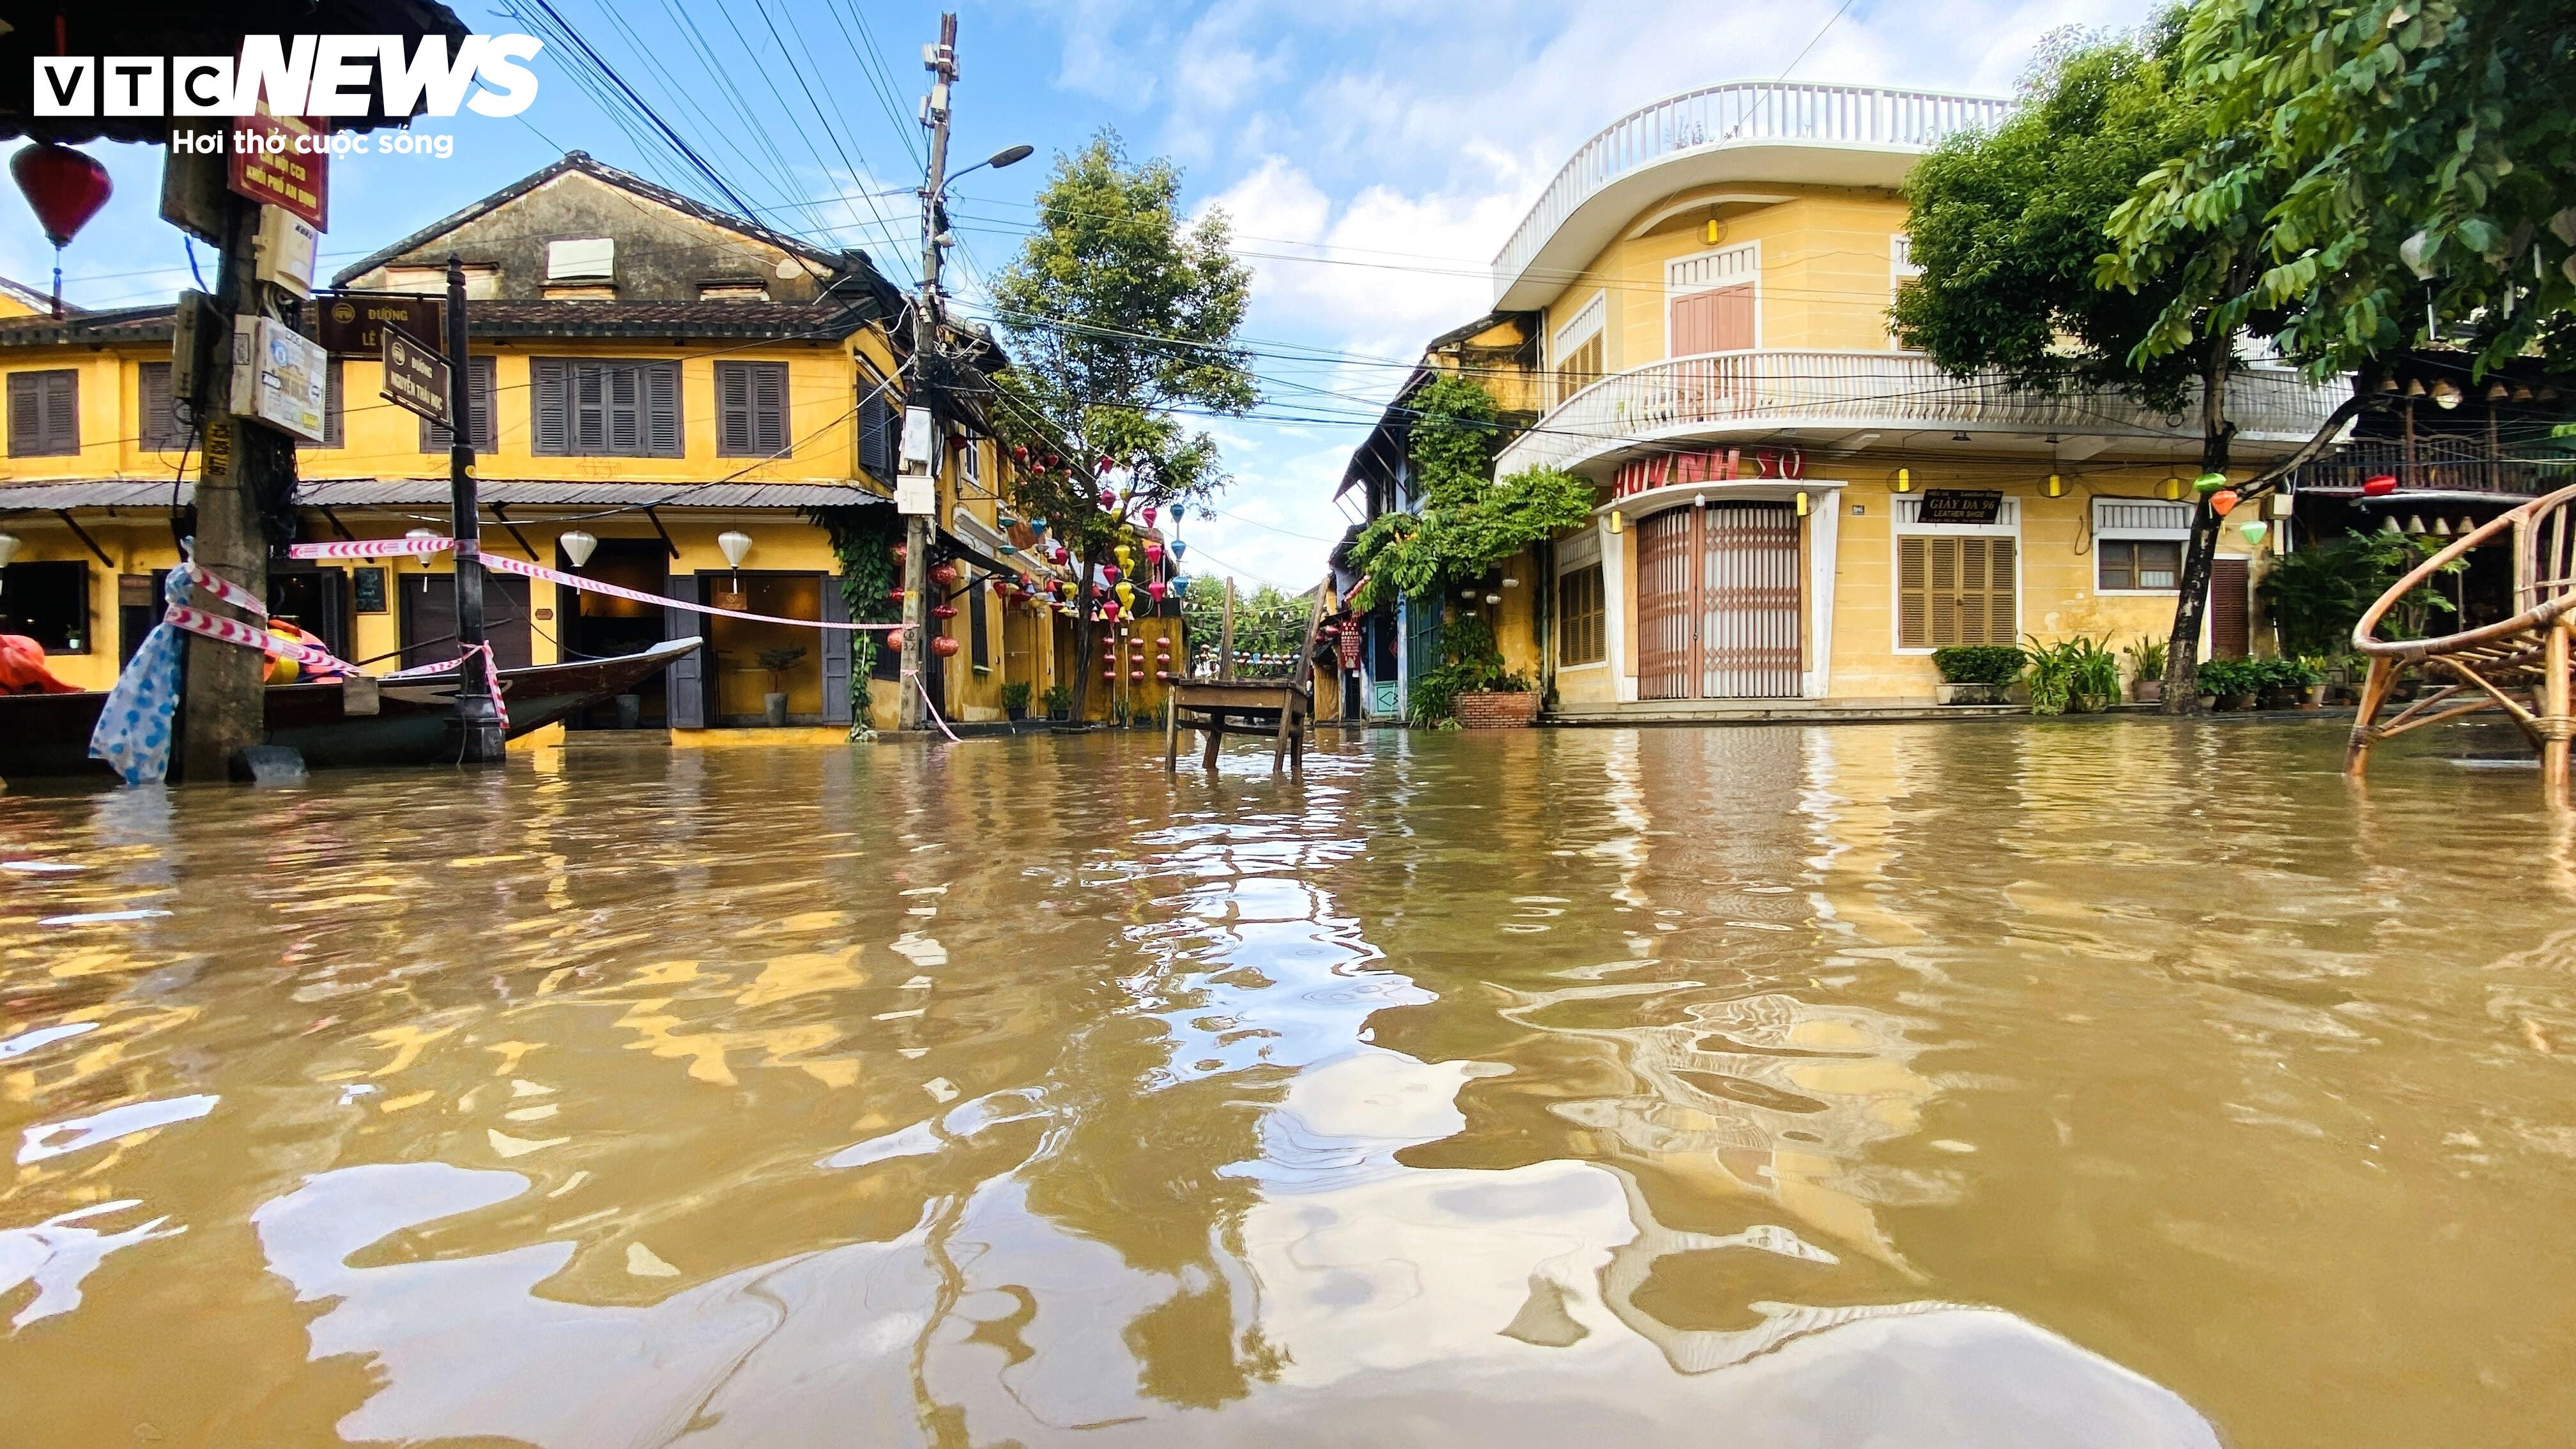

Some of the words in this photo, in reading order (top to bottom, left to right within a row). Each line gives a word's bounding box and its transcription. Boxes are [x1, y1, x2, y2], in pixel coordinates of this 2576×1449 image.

[362, 329, 377, 346] LÊ
[390, 370, 415, 397] NGUYỄN
[415, 383, 431, 403] THÁI
[1962, 500, 1978, 509] DA
[1982, 500, 1995, 510] 96
